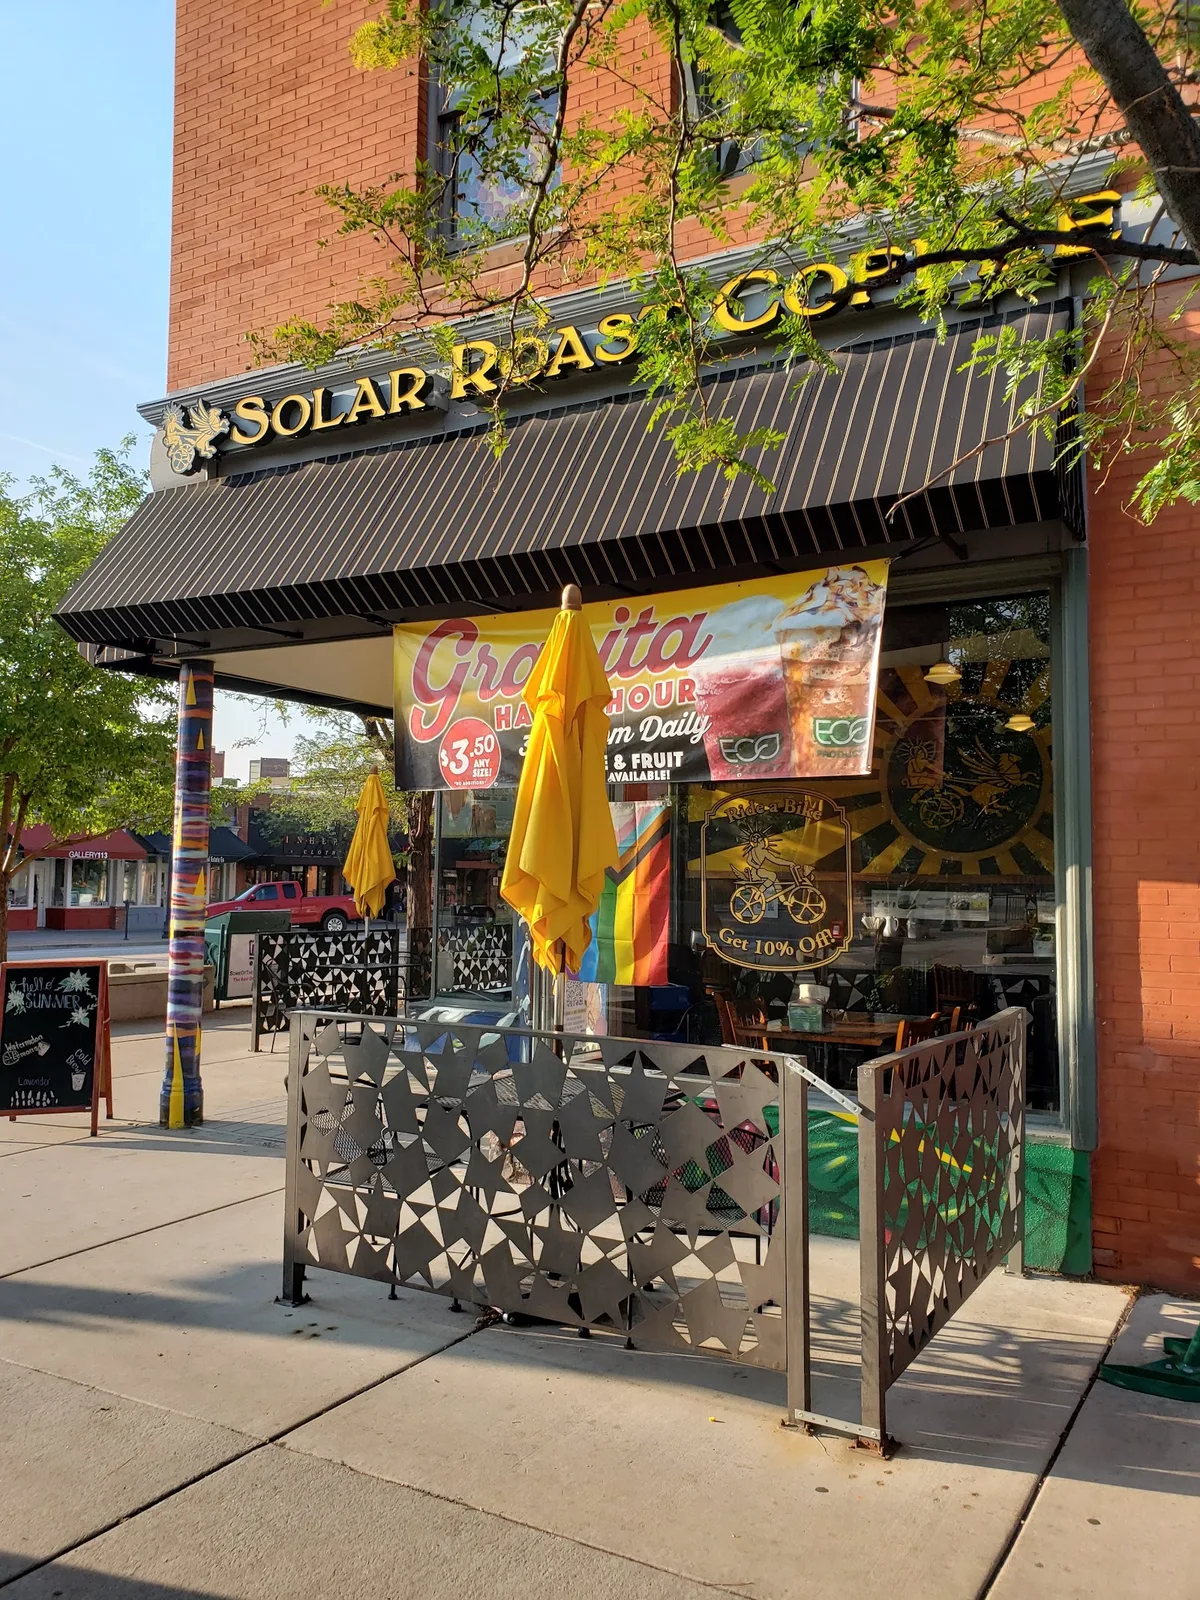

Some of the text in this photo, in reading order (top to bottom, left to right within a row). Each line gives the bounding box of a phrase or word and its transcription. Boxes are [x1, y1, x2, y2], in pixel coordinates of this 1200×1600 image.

[230, 367, 427, 445] SOLAR
[450, 302, 684, 399] ROAS
[410, 605, 714, 743] Graita
[605, 677, 698, 715] HOUR
[640, 711, 712, 744] Daily
[441, 734, 495, 775] $3.50
[631, 751, 684, 769] FRUIT
[719, 733, 780, 764] ECO
[472, 768, 493, 778] SIZE!
[473, 759, 490, 768] ANY
[608, 770, 671, 783] AVAILABLE!
[725, 801, 764, 823] Ride
[782, 798, 823, 820] Bike
[719, 927, 836, 956] Get 10% Off!
[66, 1054, 82, 1073] Brew
[74, 1048, 92, 1066] Cold
[18, 1076, 51, 1086] Lavender
